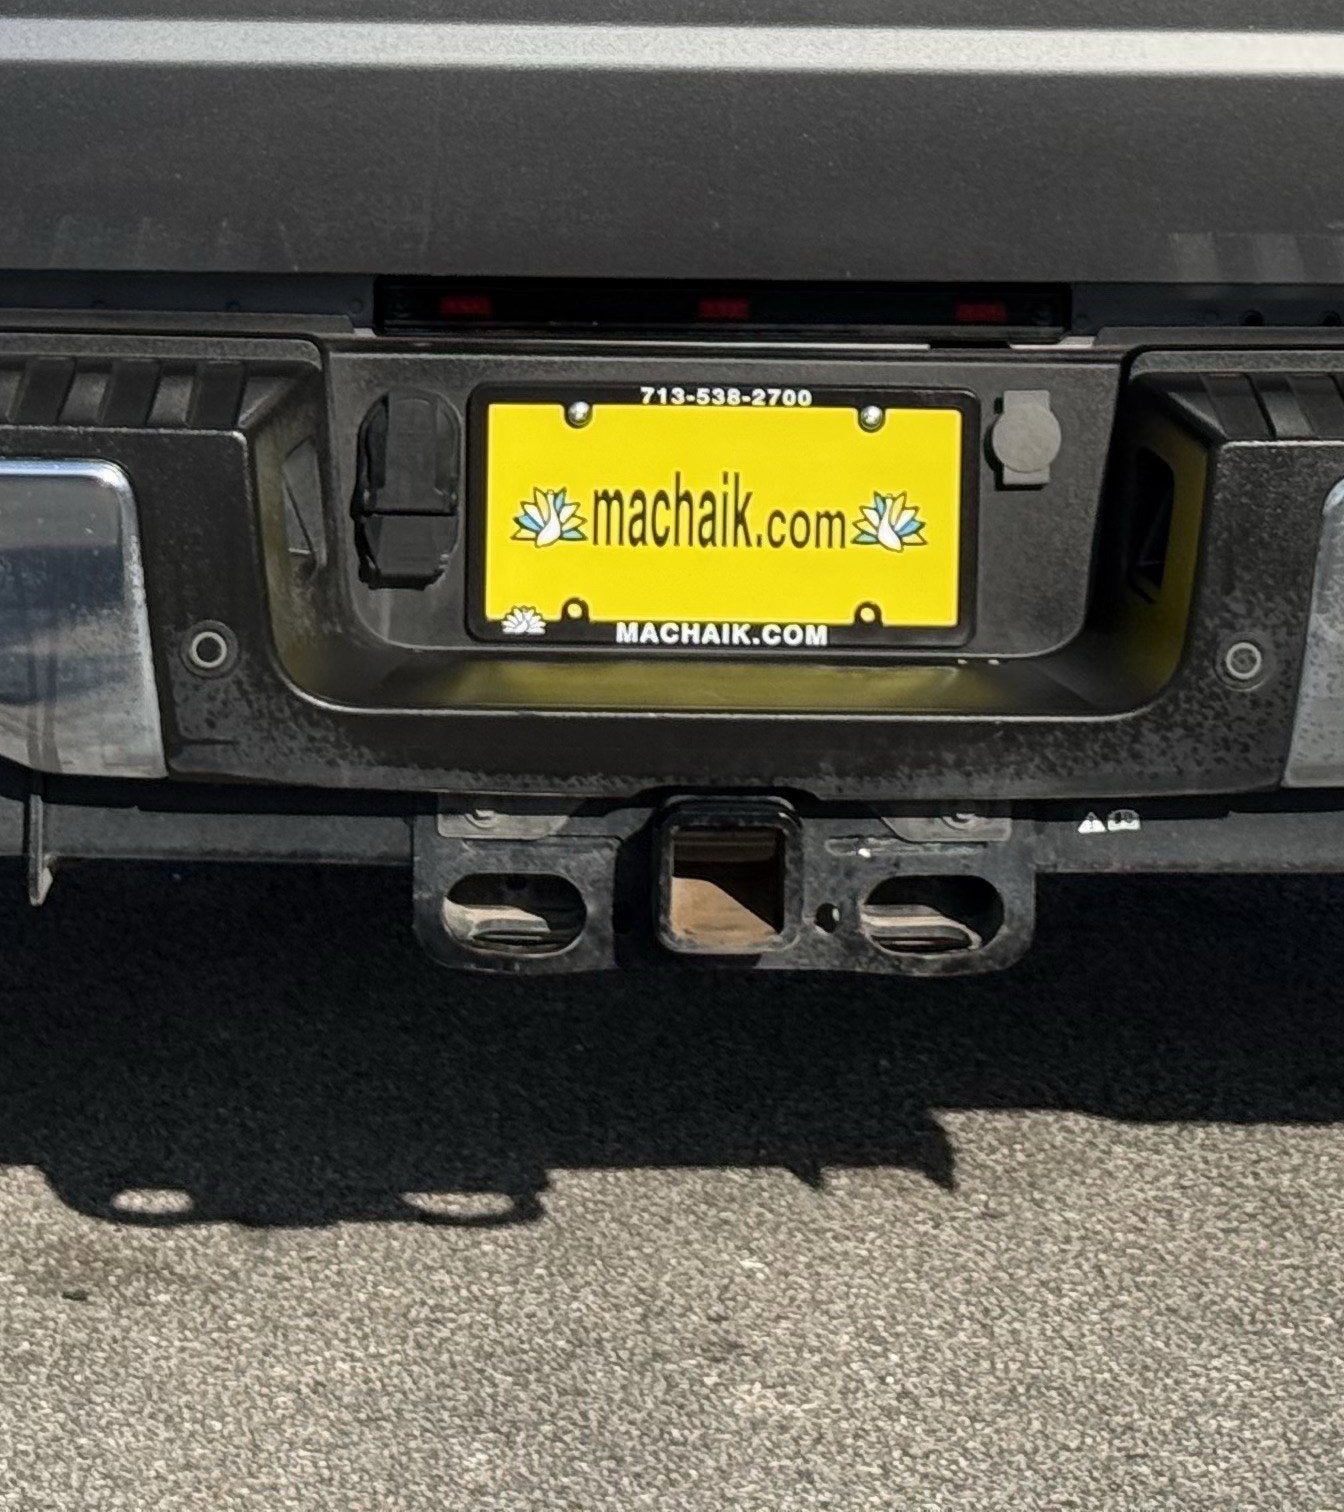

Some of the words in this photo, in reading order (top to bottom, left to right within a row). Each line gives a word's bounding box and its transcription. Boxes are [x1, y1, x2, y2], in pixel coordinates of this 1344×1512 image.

[639, 386, 813, 407] 713-538-2700
[591, 470, 847, 550] machaik.com
[615, 621, 829, 647] MACHAIK.COM
